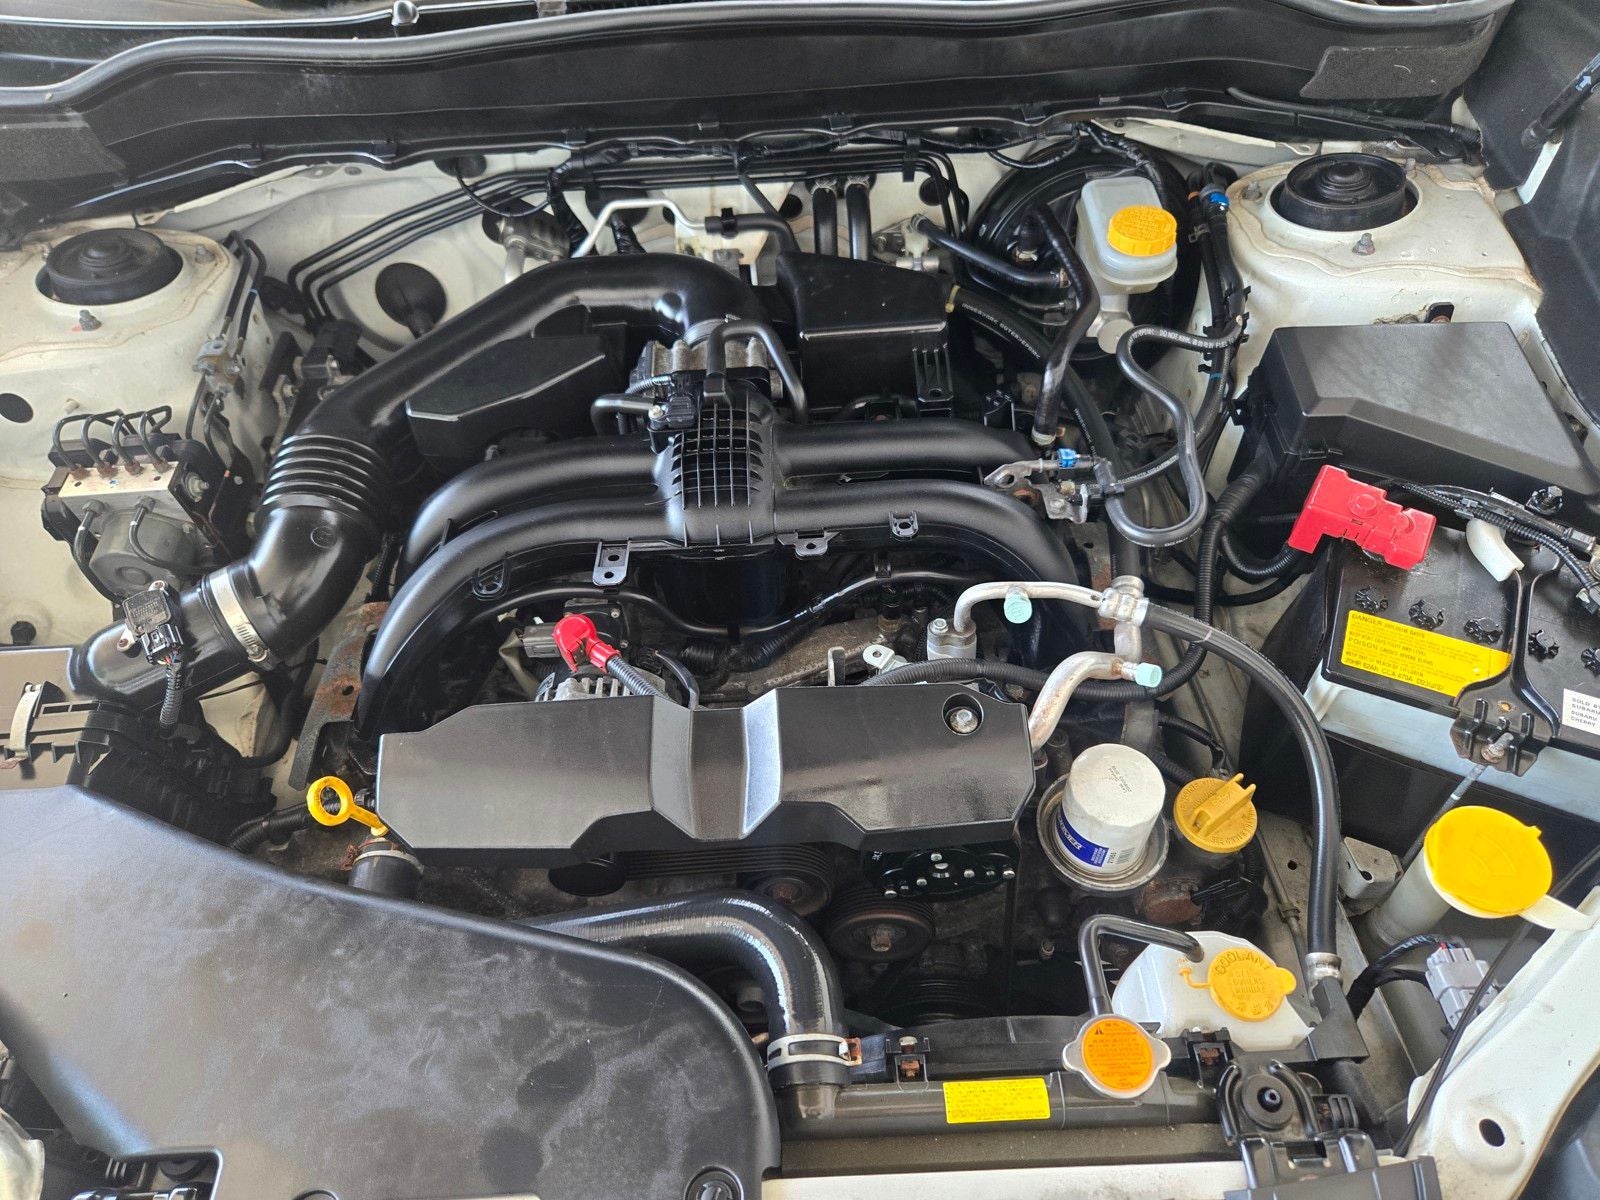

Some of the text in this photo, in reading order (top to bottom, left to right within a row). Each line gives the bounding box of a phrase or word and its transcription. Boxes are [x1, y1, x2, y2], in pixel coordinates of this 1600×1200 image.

[1351, 613, 1382, 626] DANGER
[1348, 636, 1378, 649] POISON
[1572, 698, 1590, 706] SOLD
[1214, 951, 1270, 976] COOLANT
